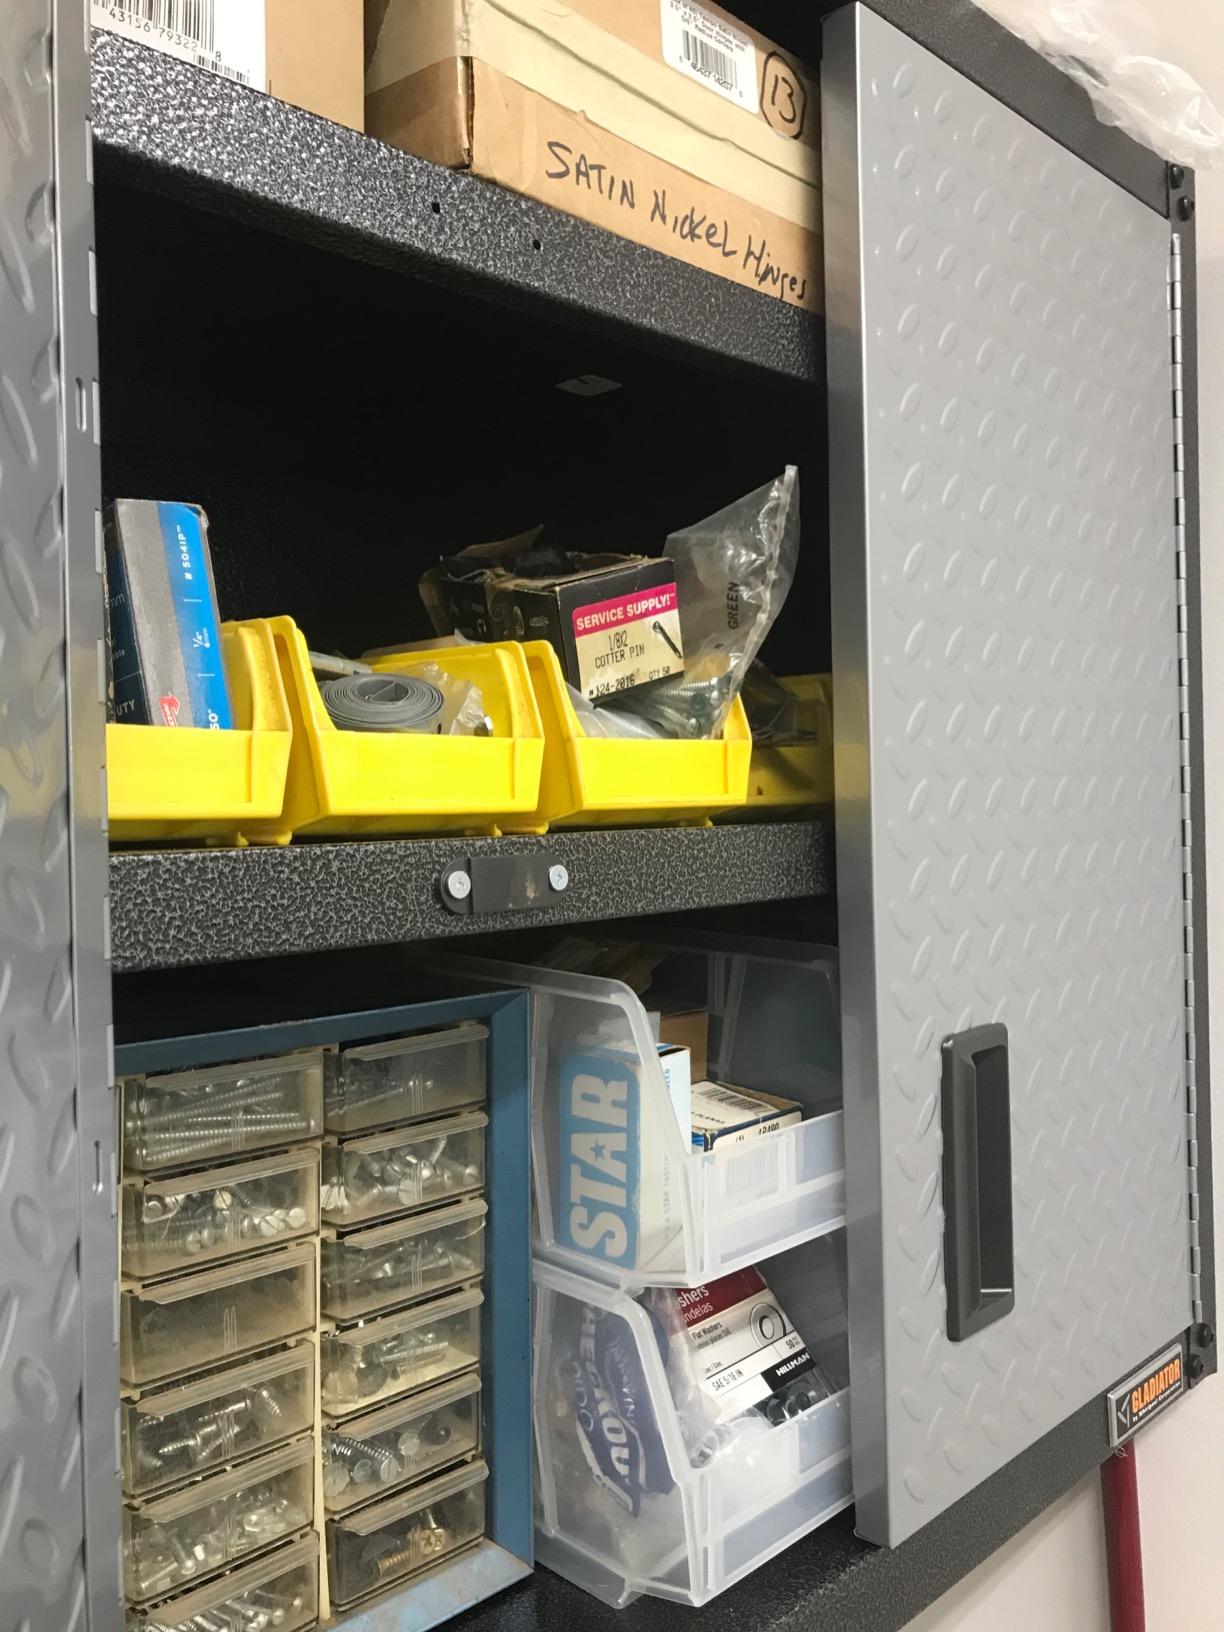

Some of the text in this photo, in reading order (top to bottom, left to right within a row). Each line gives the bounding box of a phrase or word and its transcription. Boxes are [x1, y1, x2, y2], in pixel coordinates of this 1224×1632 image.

[109, 7, 222, 62] 43156 79322 8
[770, 73, 798, 125] 13
[545, 140, 636, 211] SATIN
[726, 580, 740, 630] GREEN
[576, 607, 625, 631] SERVICE
[595, 643, 645, 670] COTTER PIN
[648, 665, 671, 681] QTY 50
[115, 699, 136, 717] UTY
[569, 1073, 629, 1258] STAR
[678, 1284, 710, 1308] shers
[702, 1320, 723, 1336] Washers
[775, 1352, 811, 1377] HILLMAN
[711, 1379, 725, 1392] SAE
[1131, 1358, 1181, 1414] GLADIATOR
